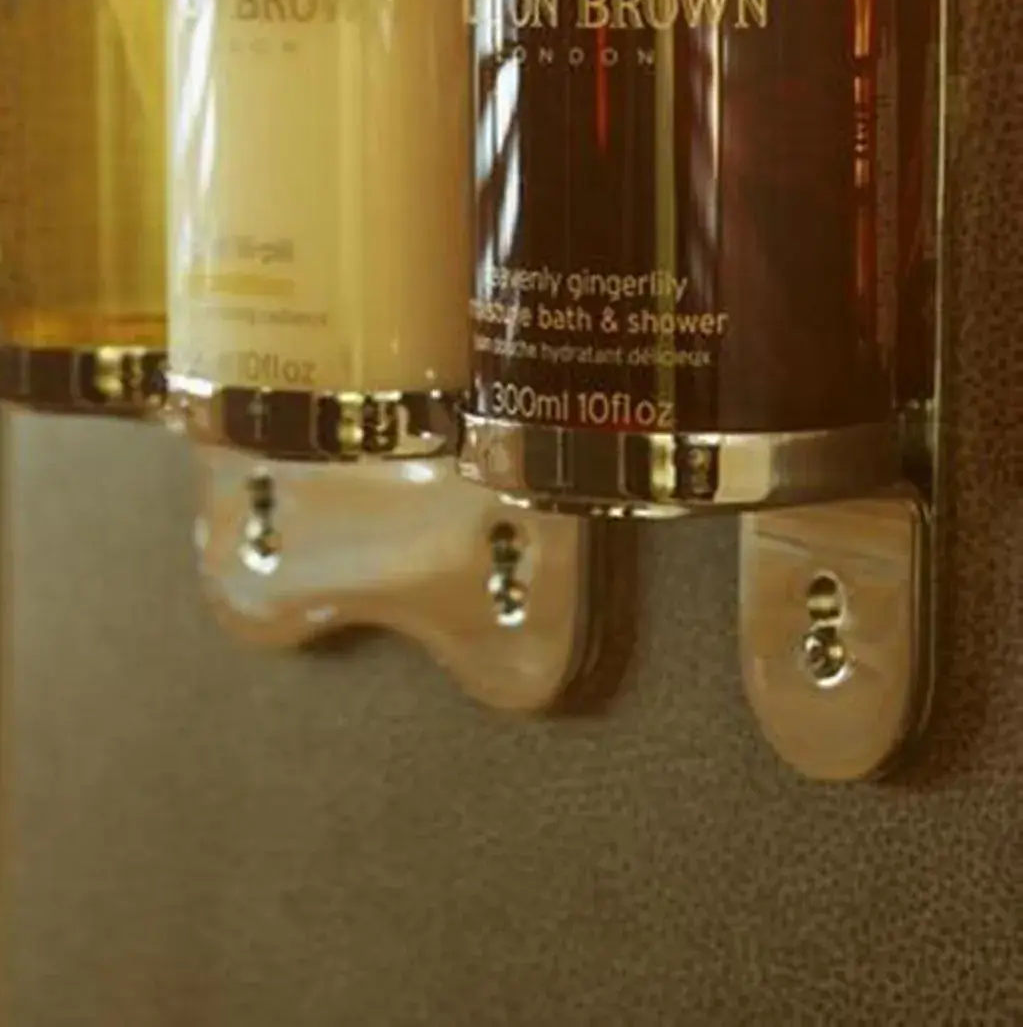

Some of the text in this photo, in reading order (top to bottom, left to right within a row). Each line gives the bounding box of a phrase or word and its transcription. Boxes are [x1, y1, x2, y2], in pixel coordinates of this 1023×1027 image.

[568, 271, 688, 303] gingerlily
[537, 303, 593, 332] bath
[600, 307, 619, 334] &
[627, 308, 729, 336] shower
[492, 380, 569, 421] 300ml
